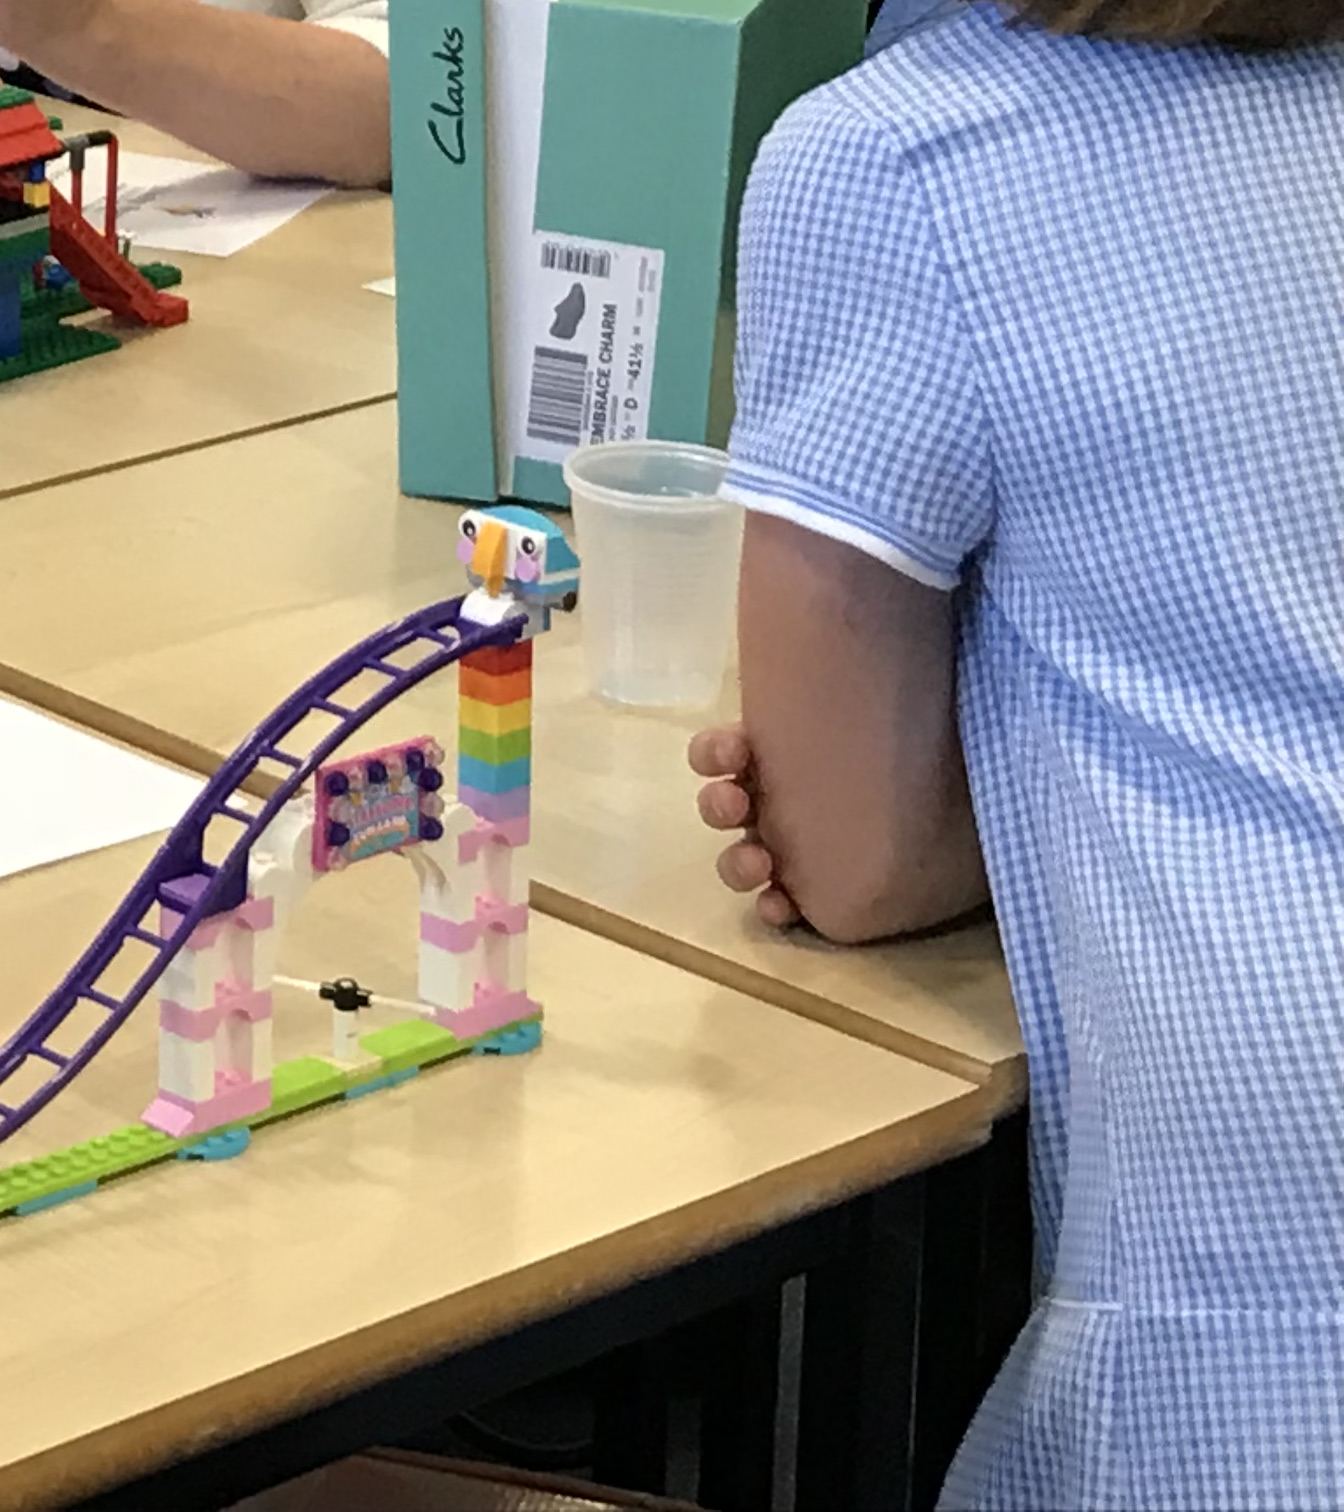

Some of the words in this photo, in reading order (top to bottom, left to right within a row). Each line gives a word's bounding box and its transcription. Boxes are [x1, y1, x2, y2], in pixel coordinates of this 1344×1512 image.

[427, 26, 466, 165] Clarks
[598, 303, 617, 364] CHARM
[590, 368, 611, 445] EMBRACE
[624, 397, 638, 410] D
